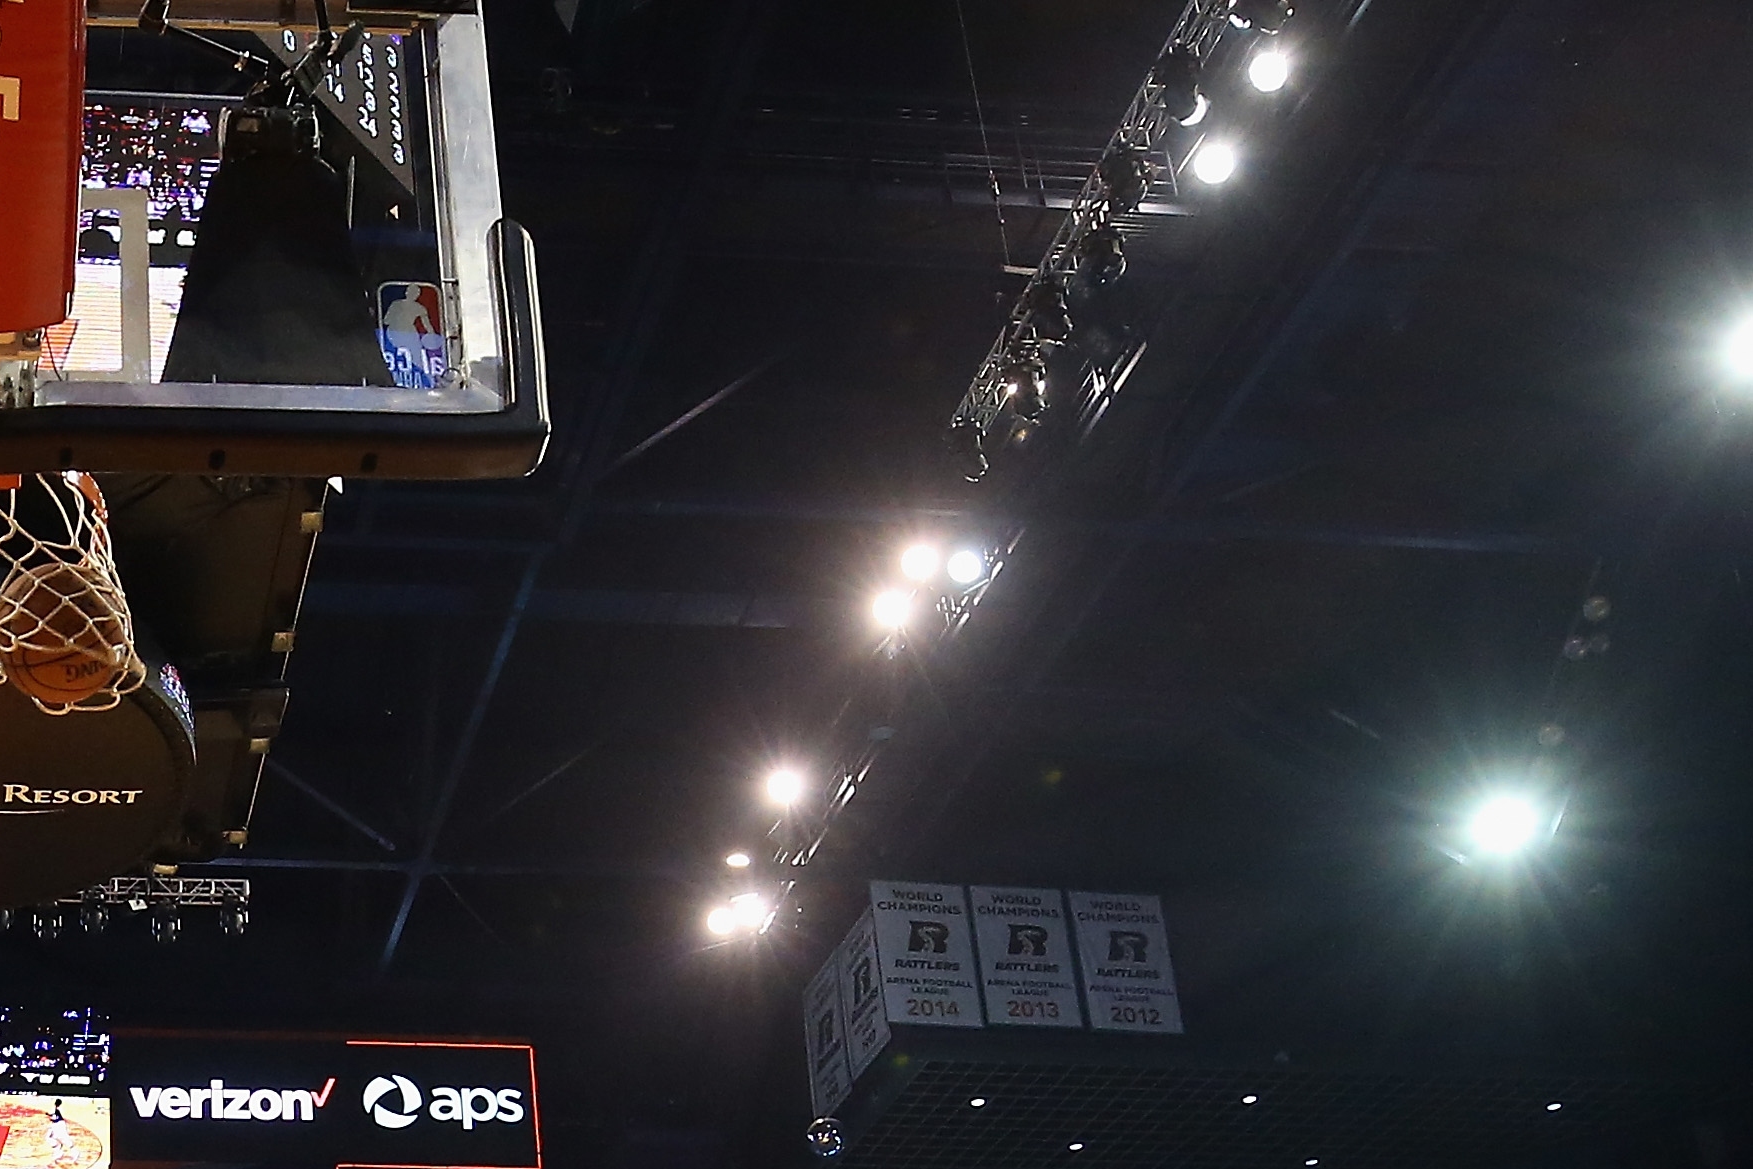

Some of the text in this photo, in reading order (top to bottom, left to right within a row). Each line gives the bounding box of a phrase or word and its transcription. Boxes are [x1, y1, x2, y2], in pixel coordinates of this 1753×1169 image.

[4, 783, 144, 806] RESORT
[892, 888, 943, 902] WORLD
[877, 900, 963, 915] CHAMPIONS
[977, 905, 1060, 920] CHAMPIONS
[894, 958, 960, 972] RATTLERS
[994, 961, 1060, 974] RATTLERS
[907, 998, 960, 1018] 2014
[1007, 1000, 1060, 1019] 2013
[1110, 1006, 1162, 1026] 2012
[129, 1078, 313, 1122] verizon
[429, 1083, 525, 1131] aps
